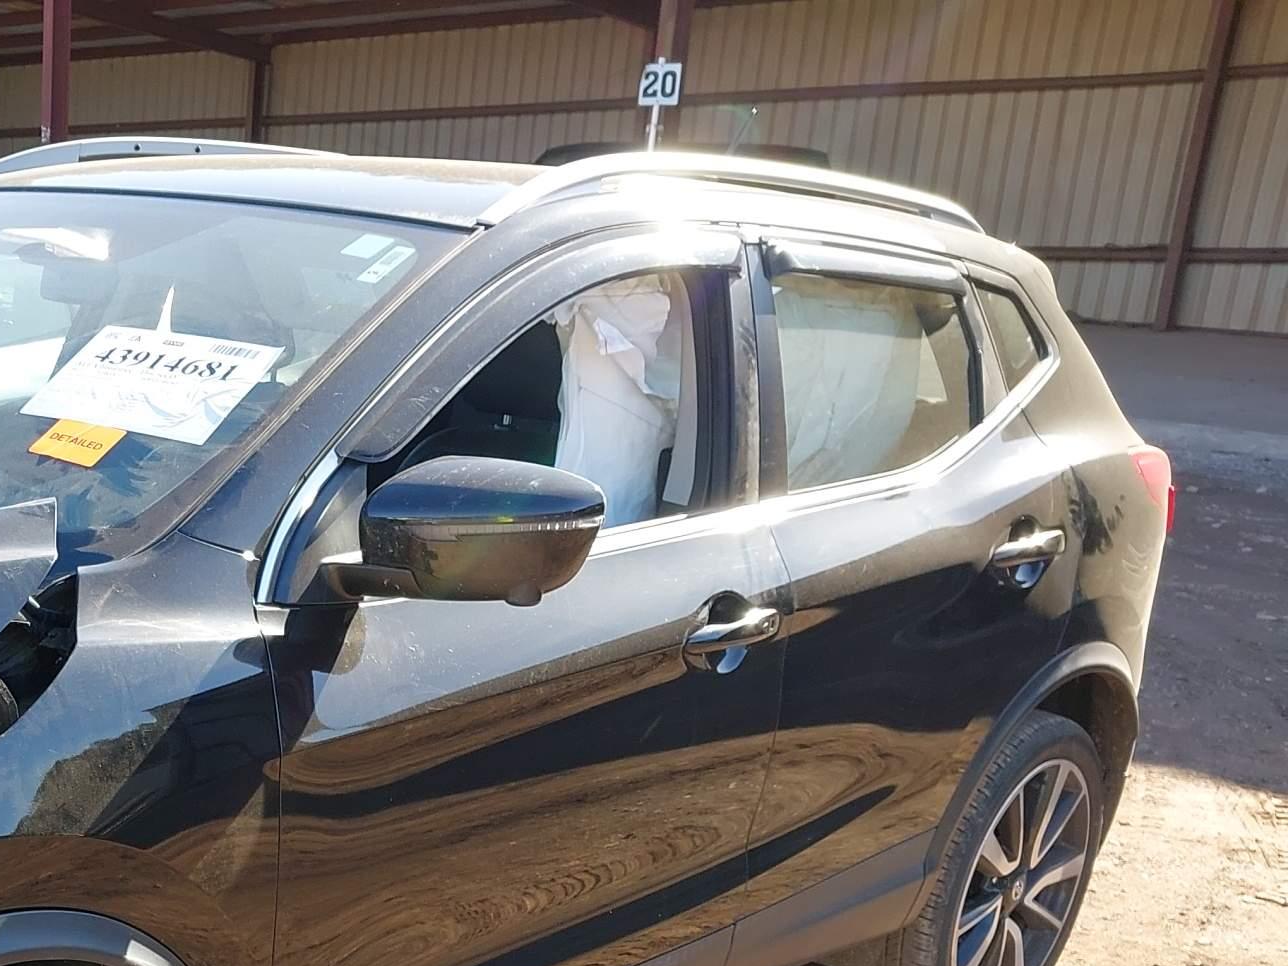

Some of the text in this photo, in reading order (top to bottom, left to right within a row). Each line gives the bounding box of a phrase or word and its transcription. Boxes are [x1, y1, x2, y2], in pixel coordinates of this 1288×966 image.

[642, 70, 677, 98] 20
[95, 346, 239, 381] 43914681
[49, 431, 104, 451] DETAILED
